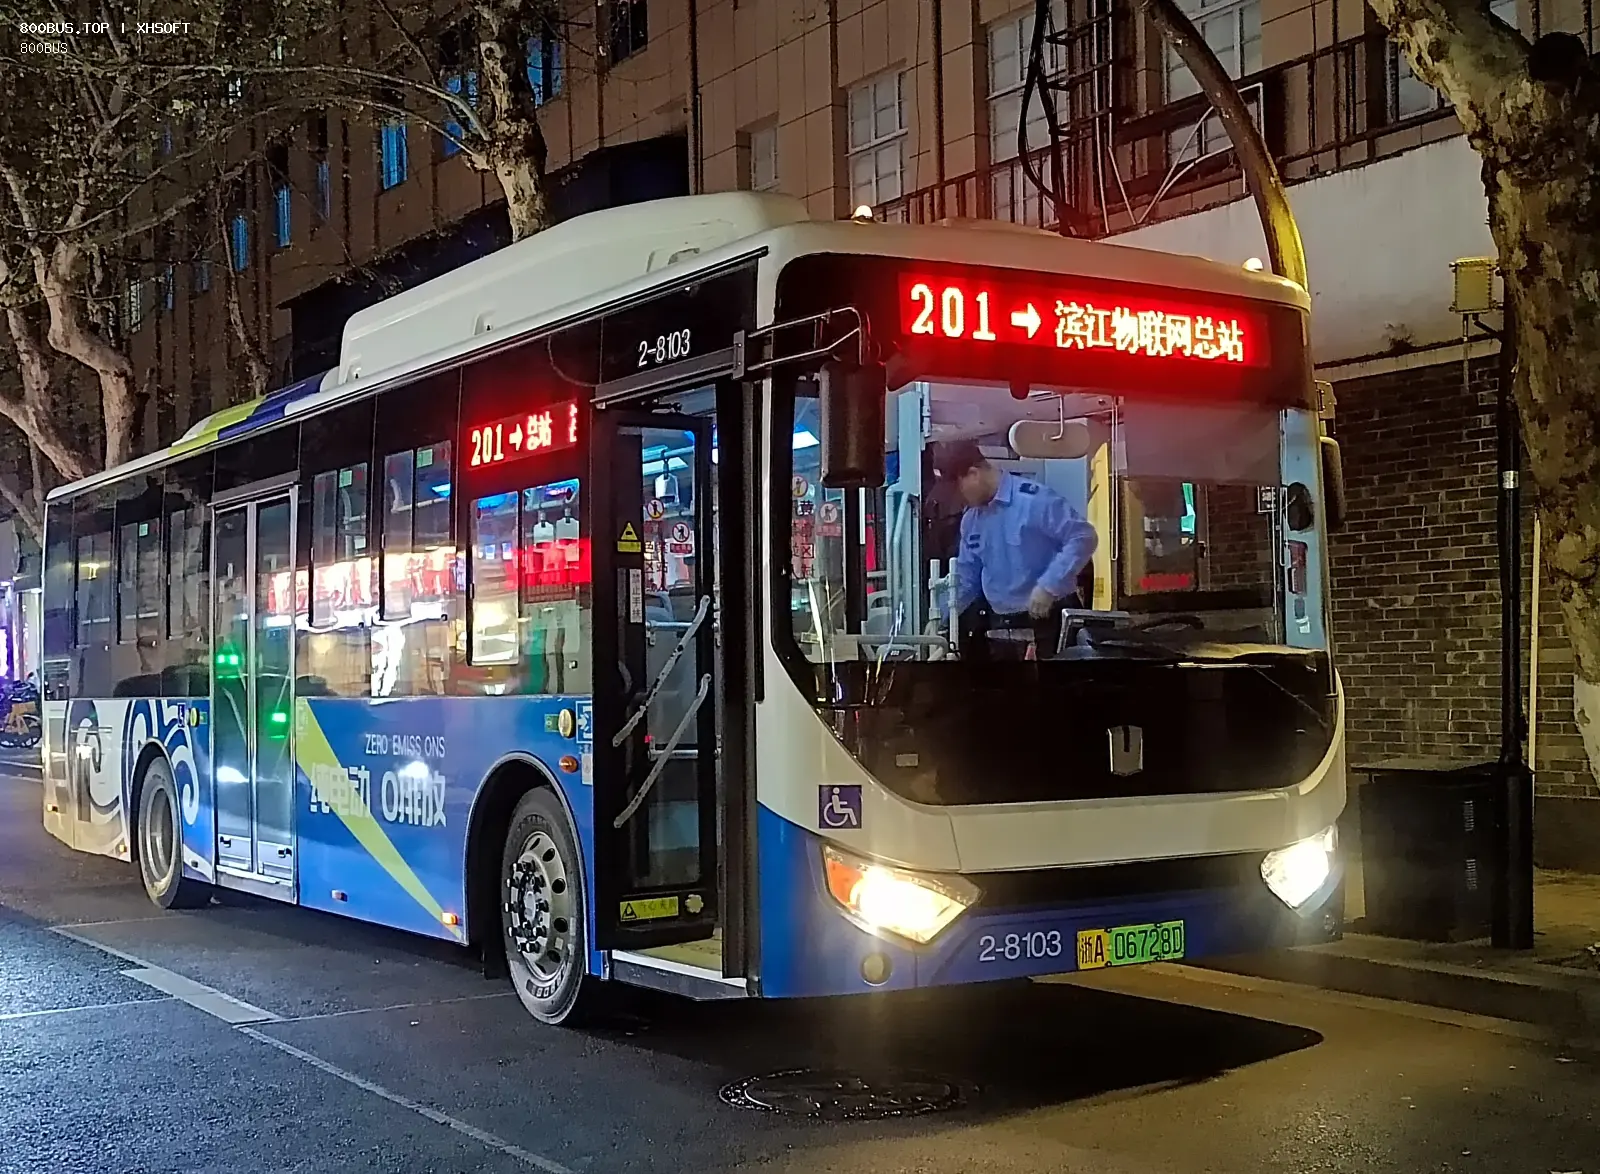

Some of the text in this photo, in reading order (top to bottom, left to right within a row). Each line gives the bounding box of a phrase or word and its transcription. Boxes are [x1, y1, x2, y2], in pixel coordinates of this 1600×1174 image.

[911, 283, 1244, 362] 201 滨江物联网总站
[638, 328, 691, 367] 2-8103
[471, 423, 504, 467] 201
[365, 733, 388, 755] ZERO
[979, 930, 1062, 962] 2-8103
